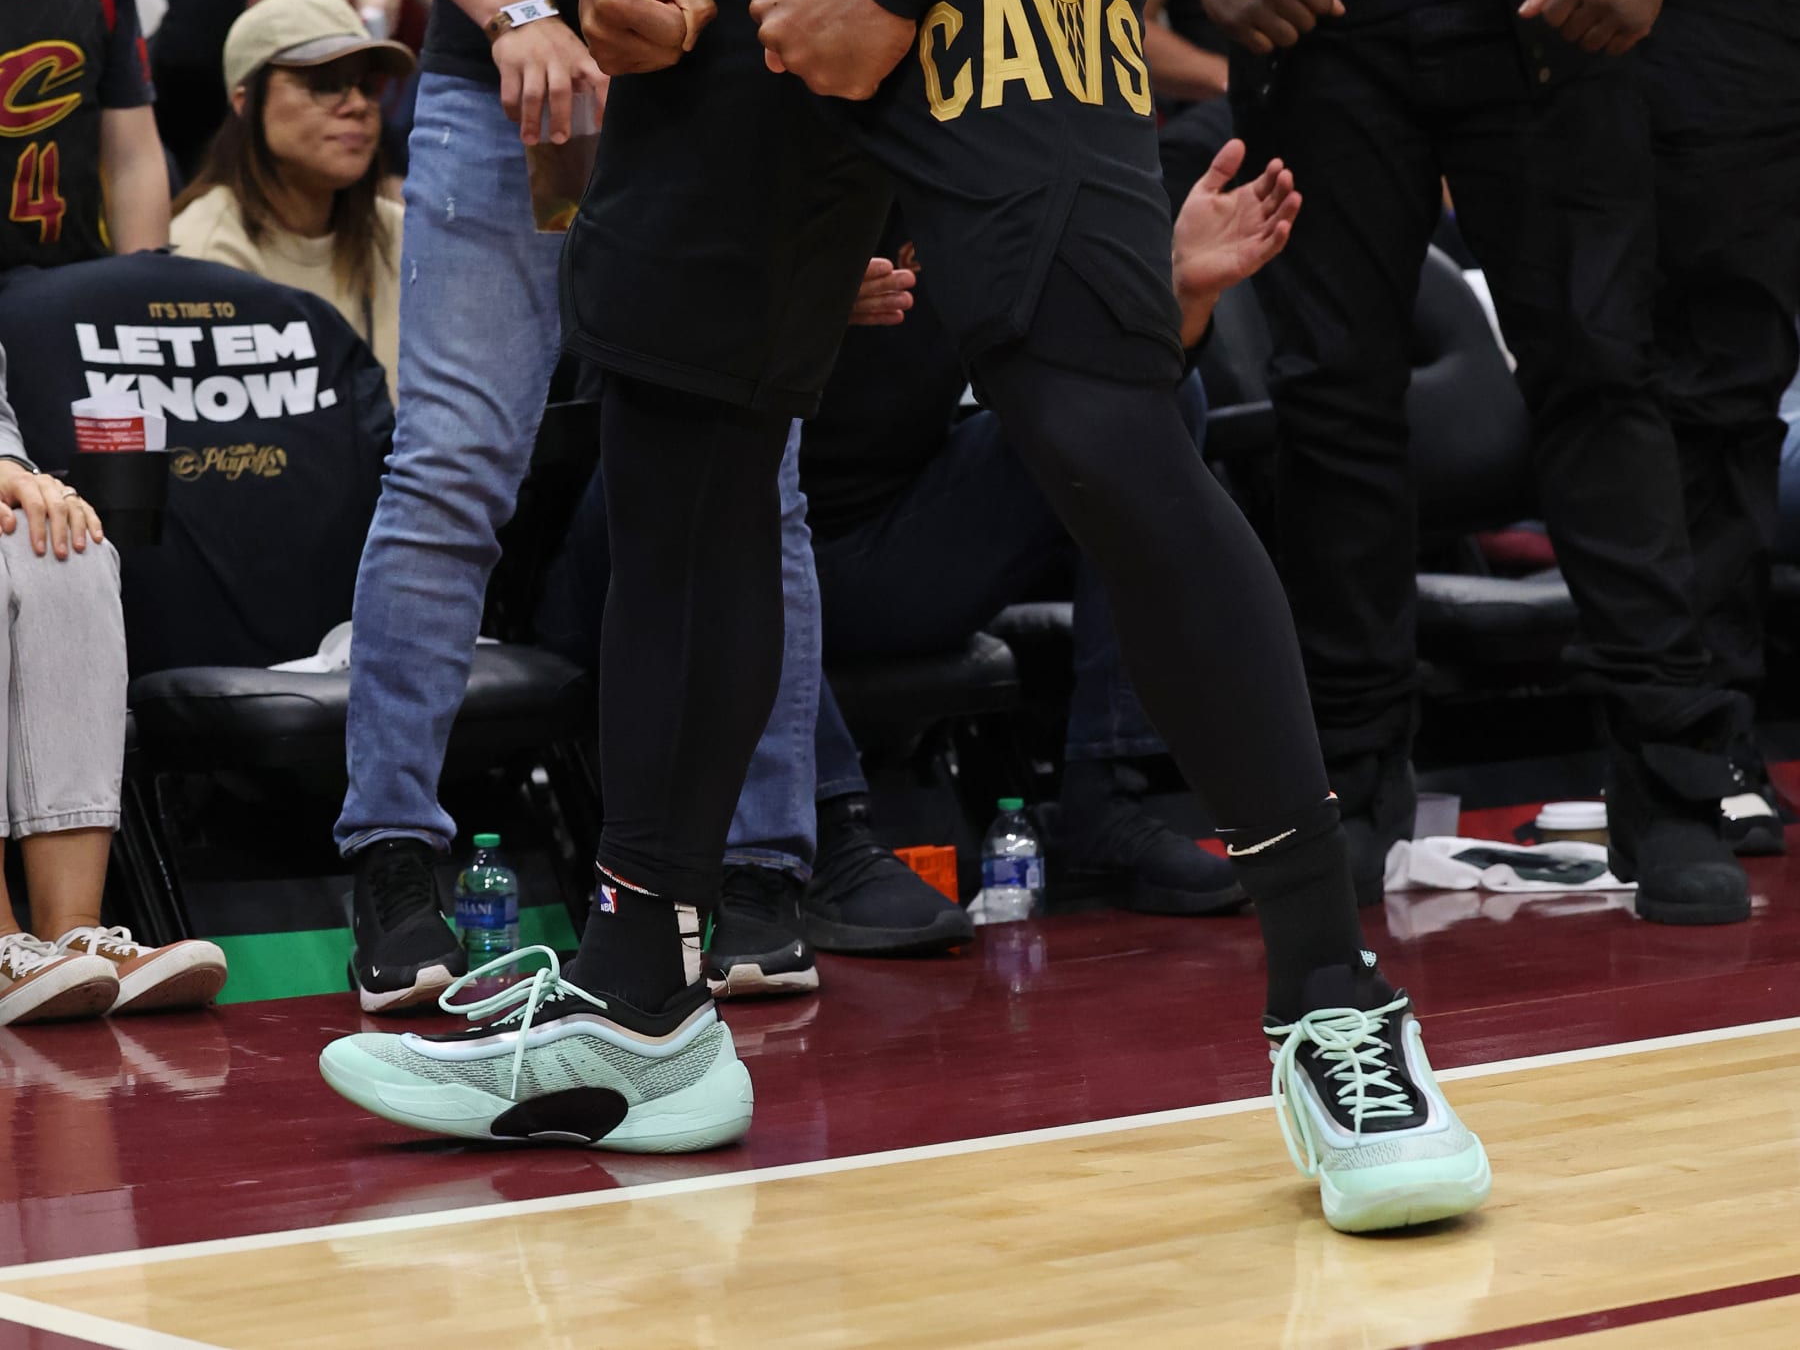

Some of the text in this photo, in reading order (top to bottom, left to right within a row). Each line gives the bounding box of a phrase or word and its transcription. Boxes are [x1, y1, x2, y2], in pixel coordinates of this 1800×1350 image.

[0, 39, 86, 137] C
[9, 141, 66, 244] 4
[148, 302, 236, 319] IT'S TIME TO
[74, 321, 317, 367] LET EM
[84, 366, 338, 422] KNOW.
